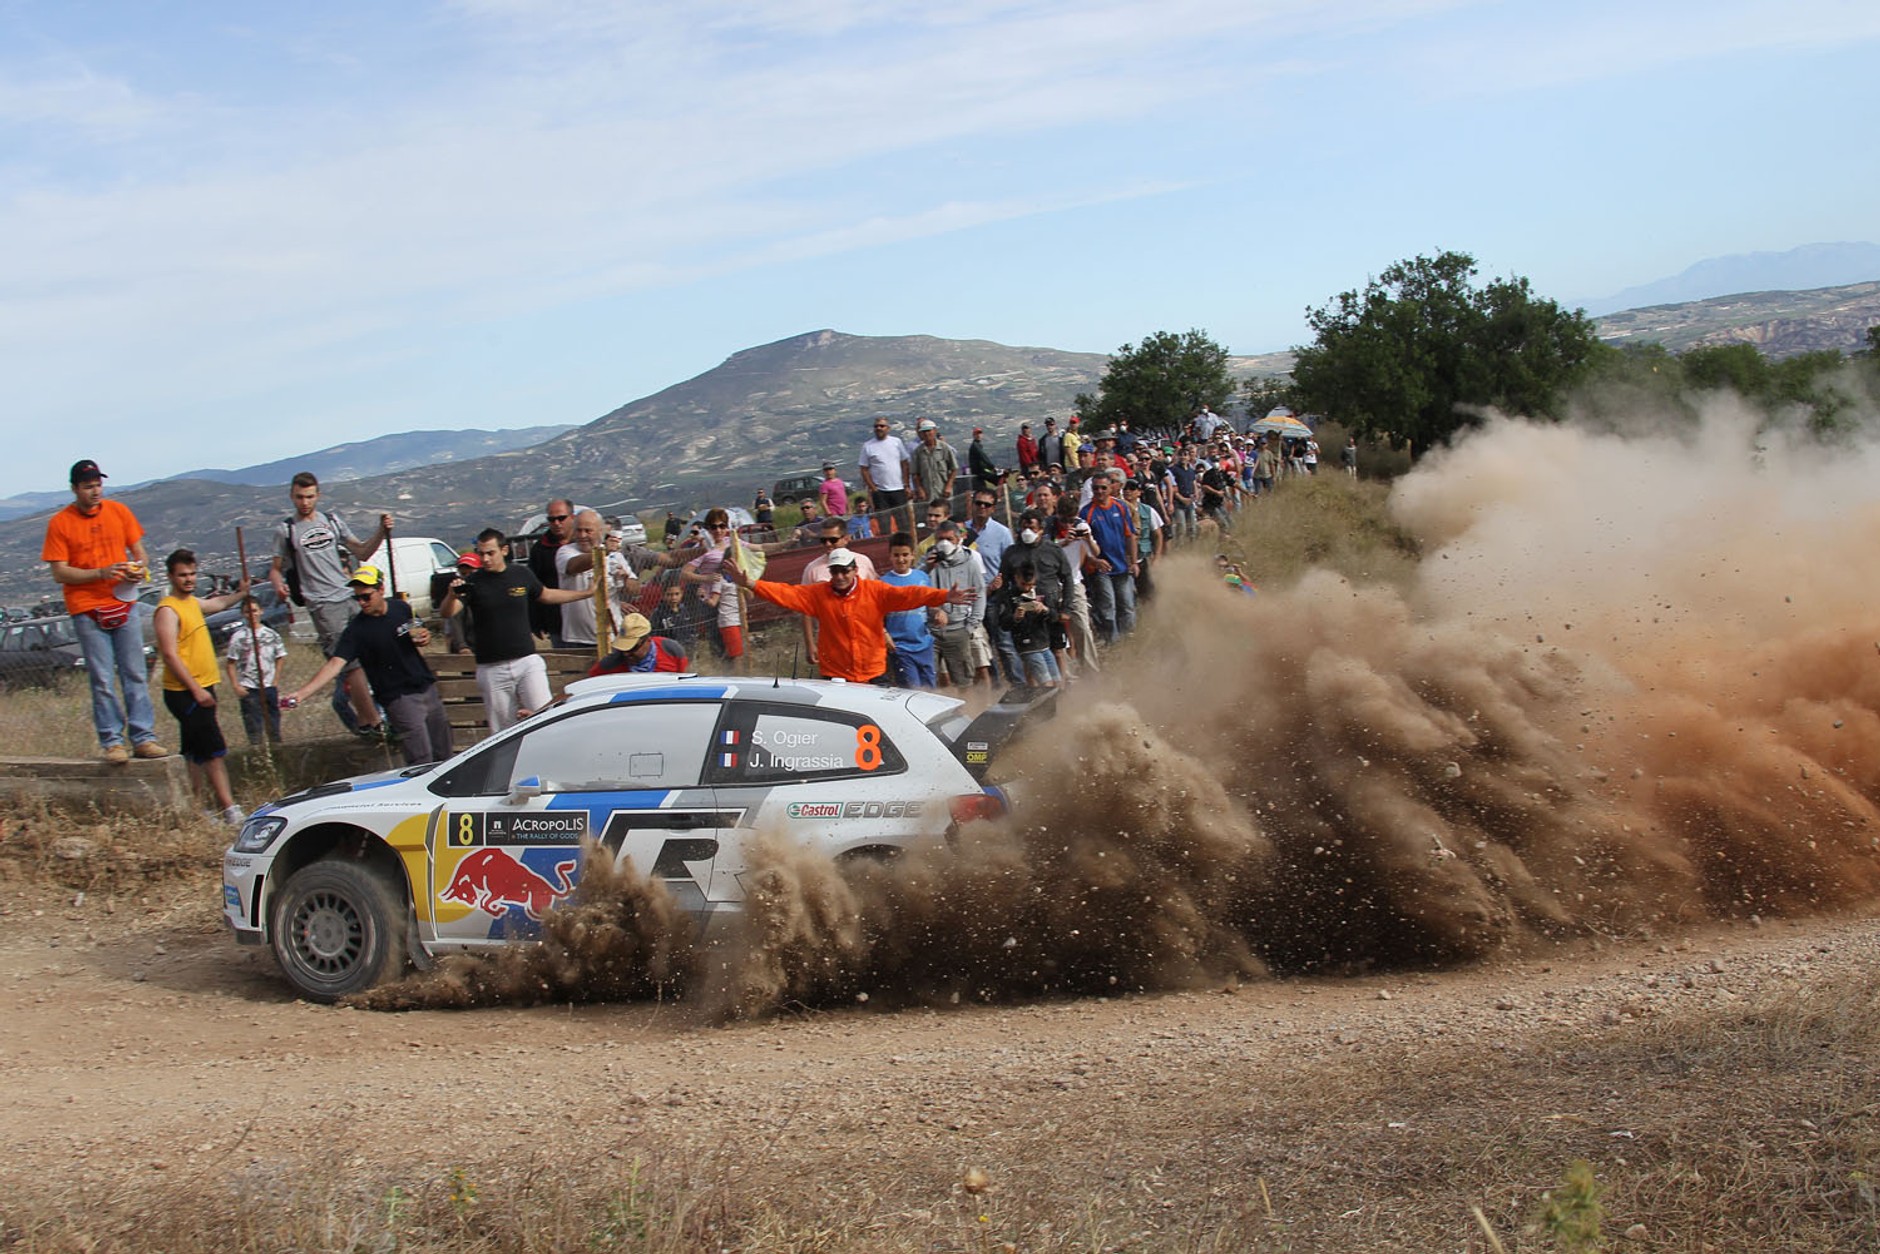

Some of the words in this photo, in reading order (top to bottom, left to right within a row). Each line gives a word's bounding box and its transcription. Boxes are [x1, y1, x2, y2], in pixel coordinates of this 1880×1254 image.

[752, 730, 767, 745] S.
[773, 730, 818, 748] Ogier
[854, 724, 882, 771] 8
[749, 753, 764, 768] J.
[770, 753, 844, 771] Ingrassia
[801, 804, 840, 817] Castrol
[842, 801, 925, 818] EDGE
[458, 813, 474, 846] 8
[512, 817, 584, 831] ACROPOLIS
[515, 832, 528, 840] THE
[529, 832, 548, 840] RALLY
[549, 832, 558, 840] OF
[559, 832, 579, 840] GODS
